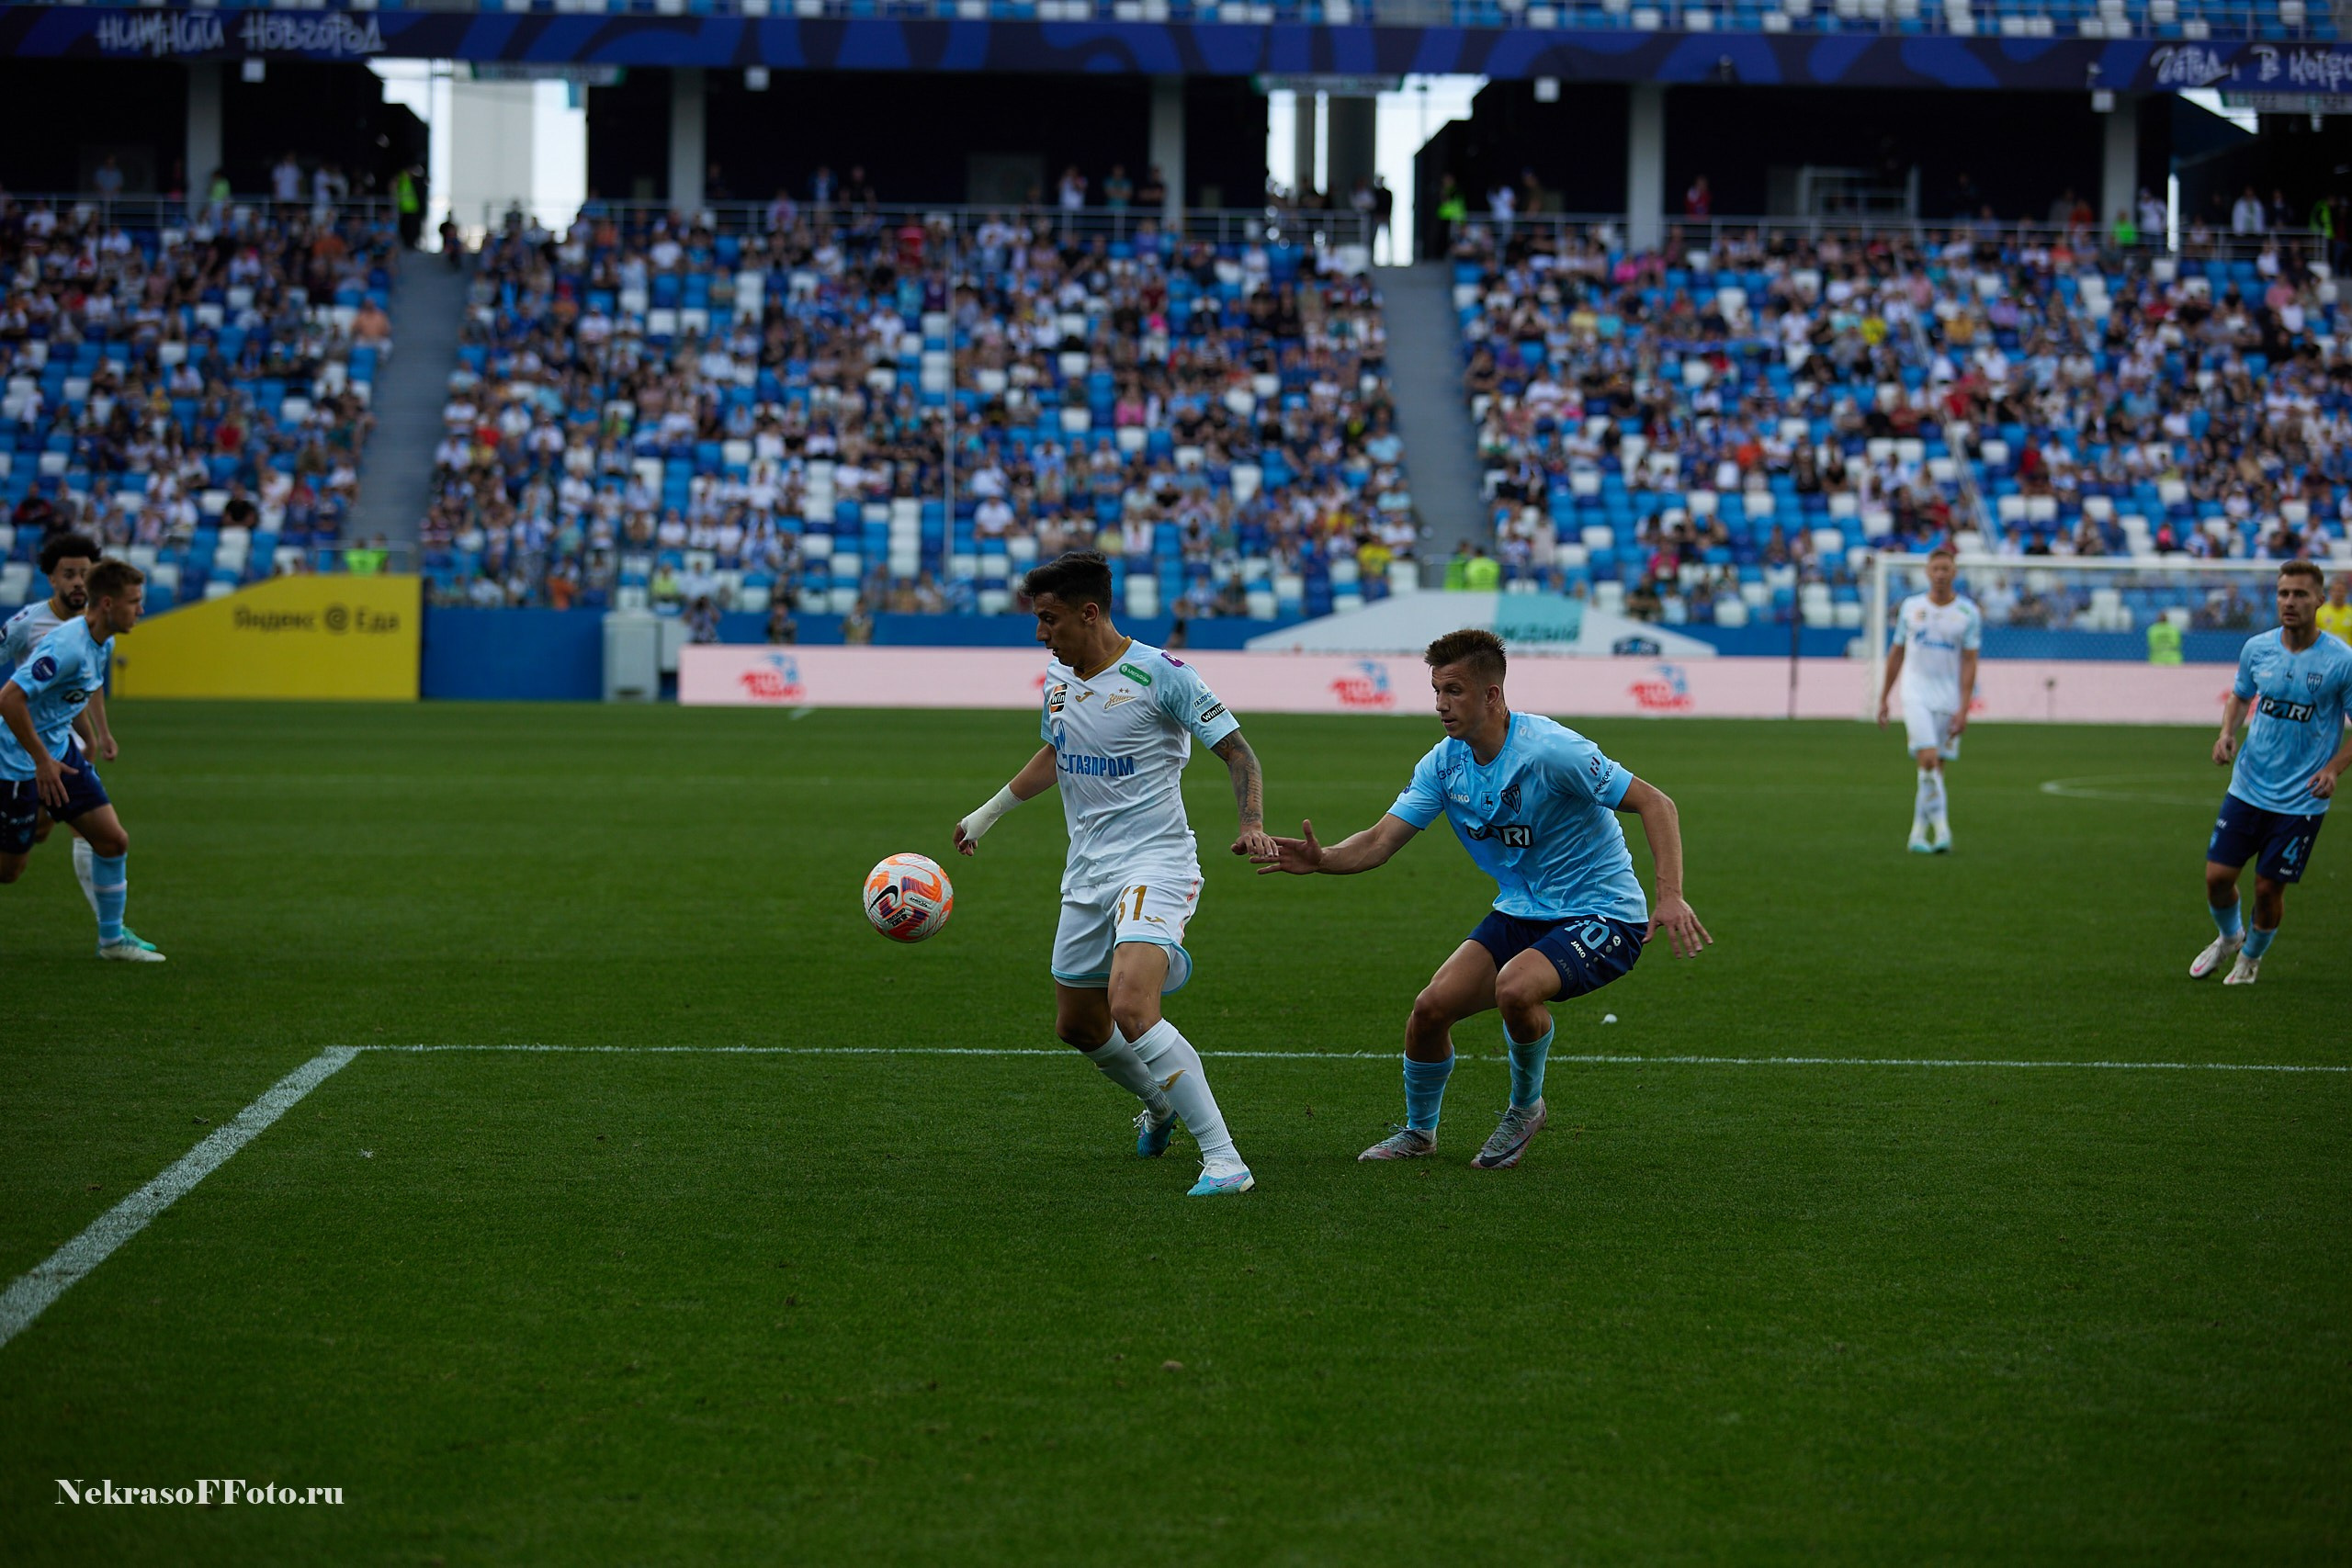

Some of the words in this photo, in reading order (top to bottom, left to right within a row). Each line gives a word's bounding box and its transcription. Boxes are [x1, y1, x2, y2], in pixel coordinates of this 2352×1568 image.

[2262, 698, 2313, 721] PARI
[1069, 754, 1135, 777] ГАЗПРОМ
[2281, 836, 2300, 865] 4
[1570, 941, 1587, 958] JAKO
